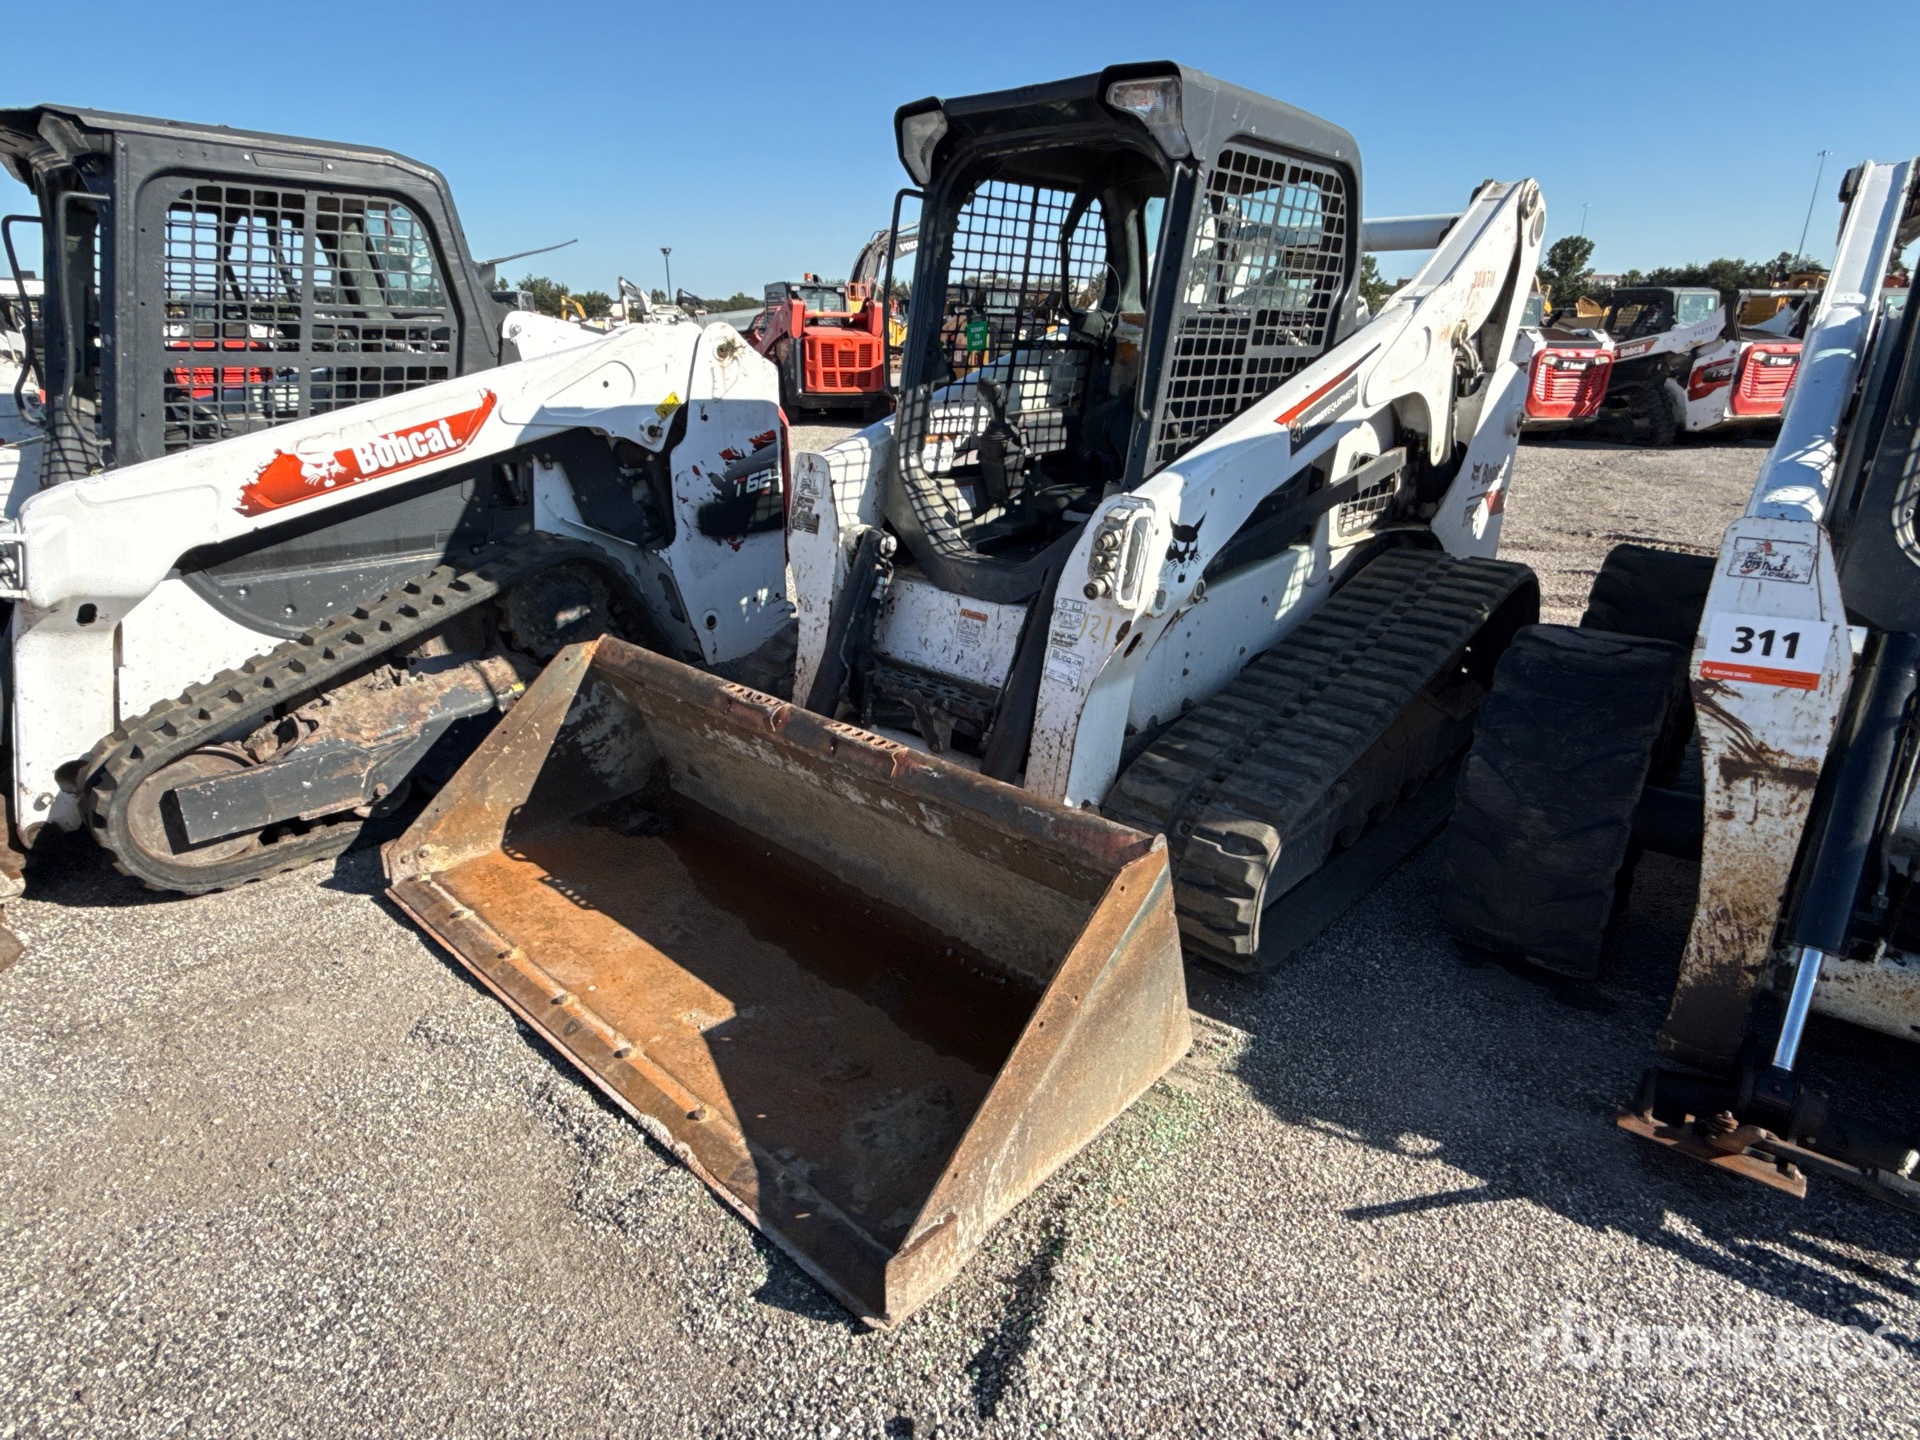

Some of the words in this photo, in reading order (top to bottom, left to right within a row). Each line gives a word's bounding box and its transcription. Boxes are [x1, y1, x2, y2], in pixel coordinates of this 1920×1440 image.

[1620, 345, 1645, 357] Bobcat
[352, 419, 457, 475] Bobcat
[1730, 626, 1800, 660] 311
